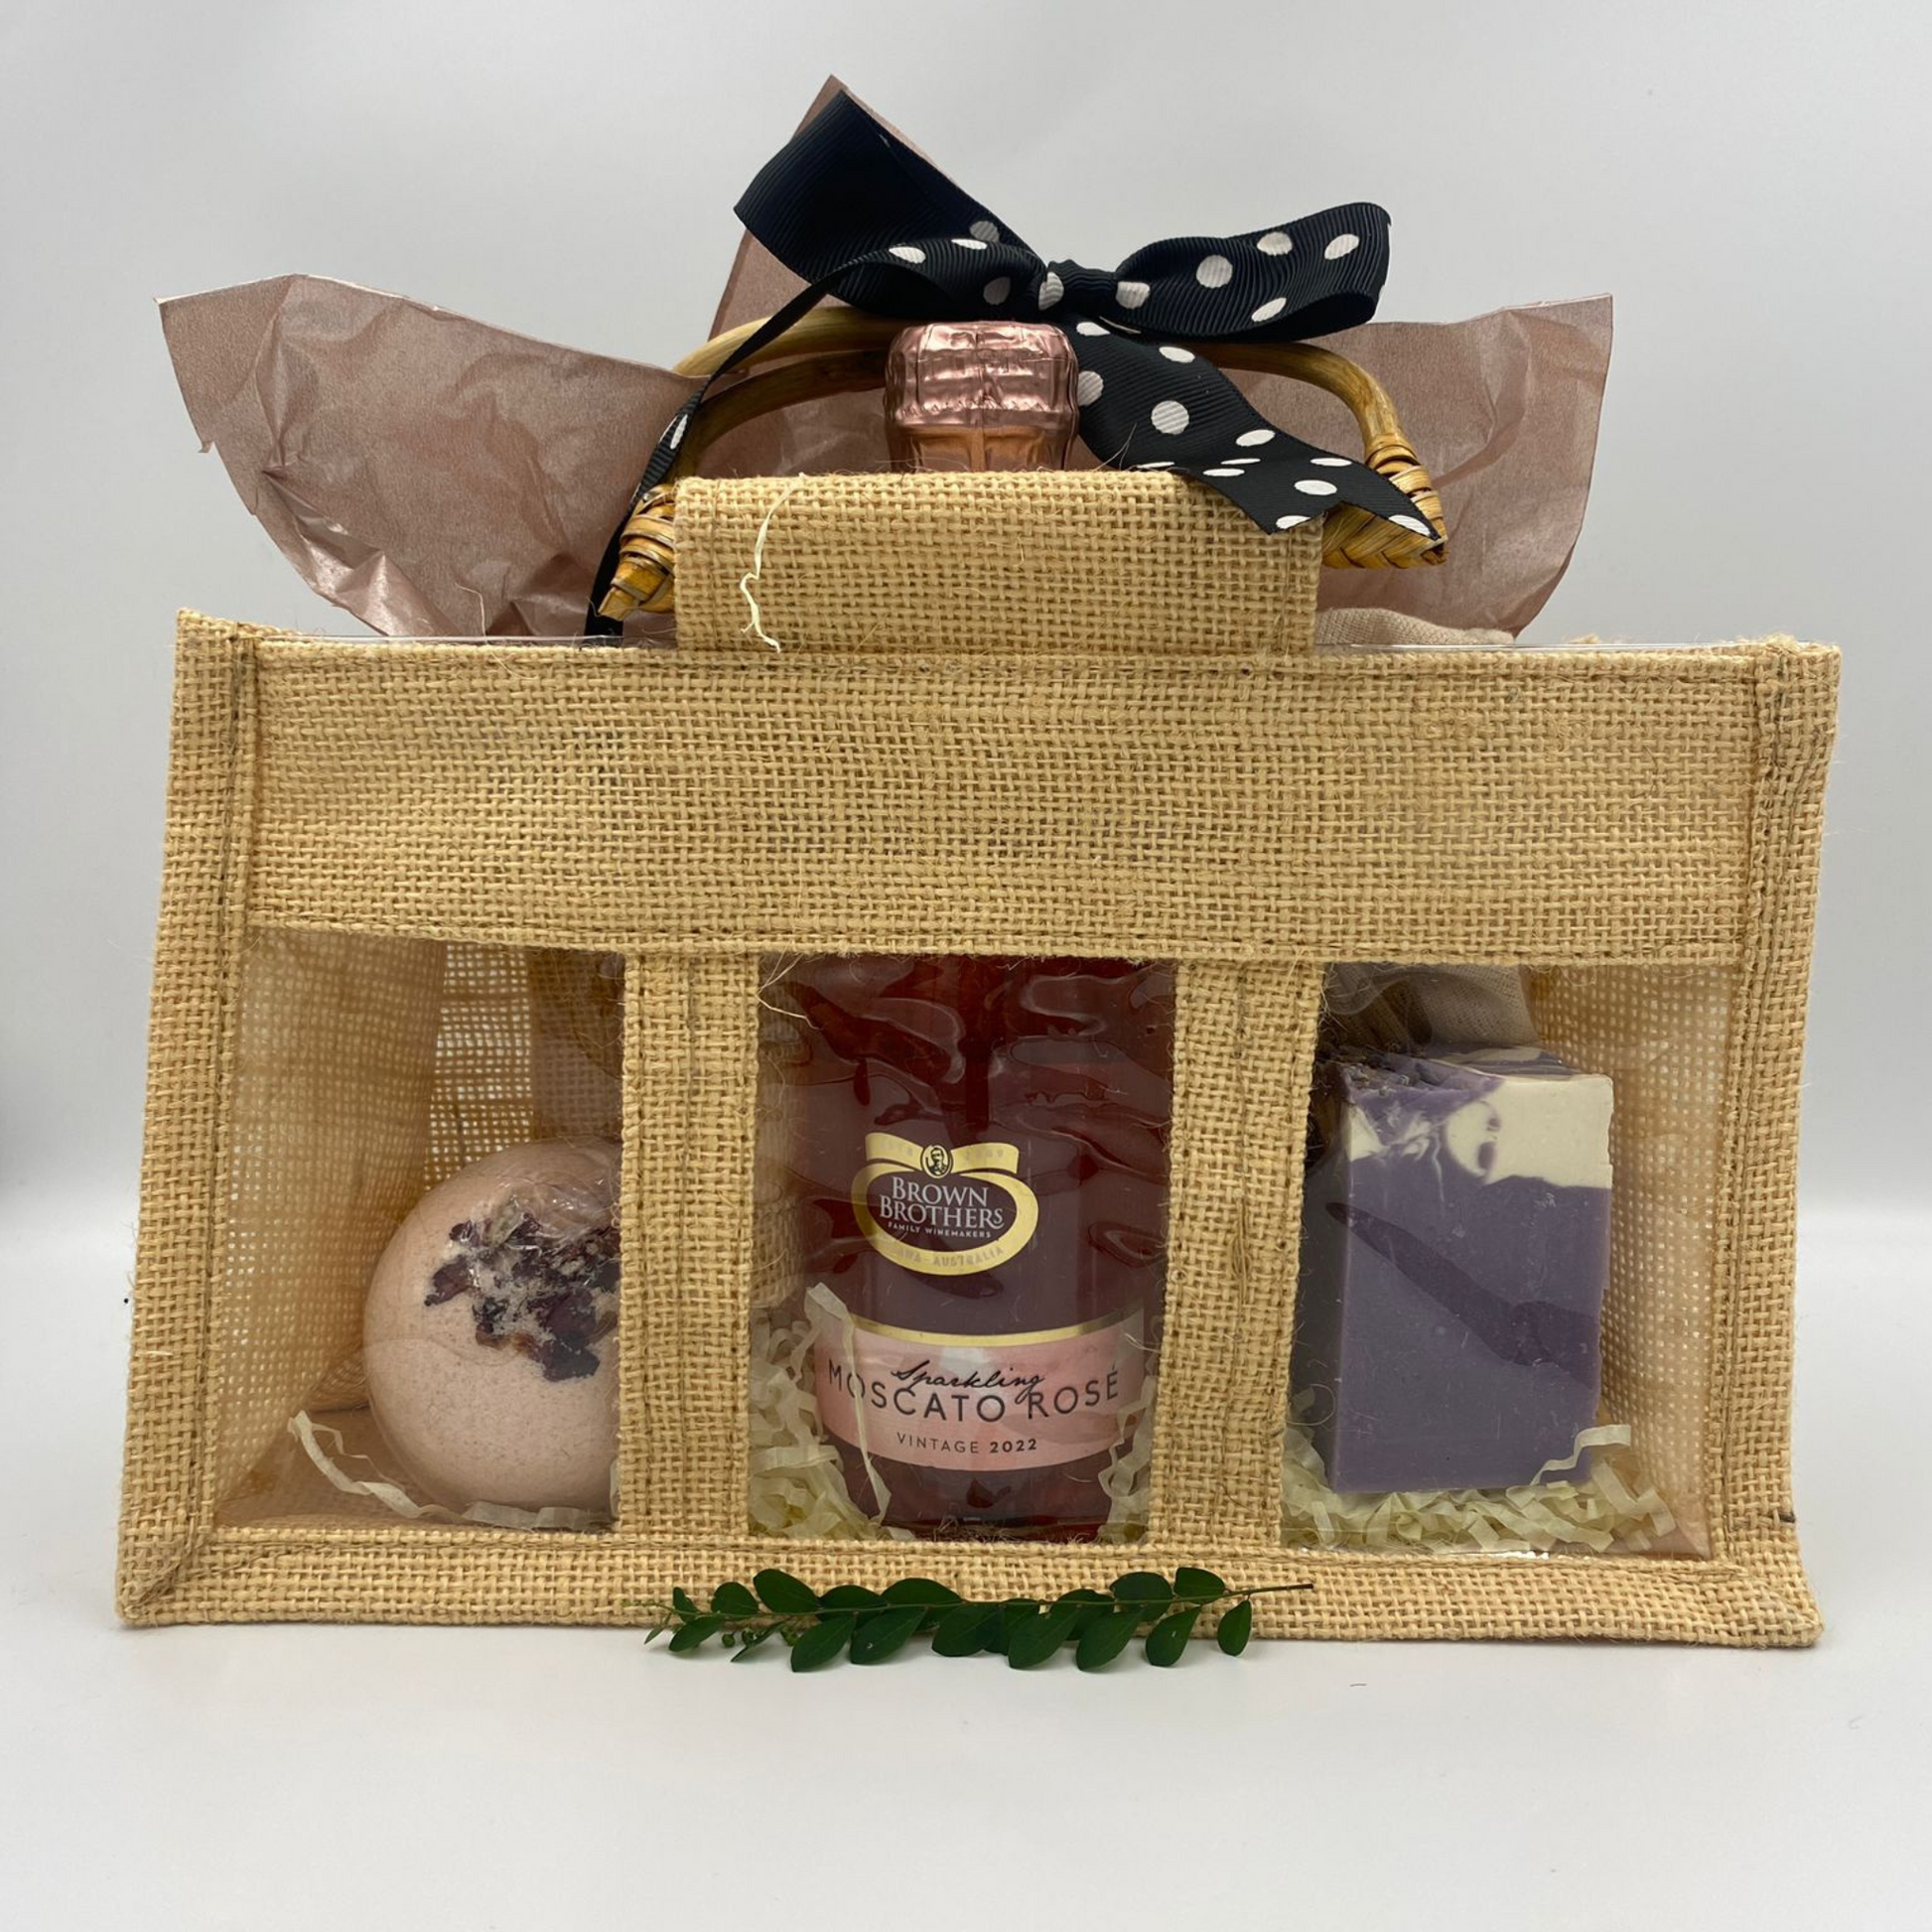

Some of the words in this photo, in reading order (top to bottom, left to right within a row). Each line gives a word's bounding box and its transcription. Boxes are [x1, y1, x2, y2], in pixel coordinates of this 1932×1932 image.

[892, 1176, 989, 1207] BROWN
[880, 1194, 1005, 1230] BROTHERS
[888, 1221, 921, 1234] FAMILY
[924, 1227, 992, 1239] WINEMAKERS
[932, 1246, 1005, 1268] AUSTRALIA
[828, 1358, 1006, 1423] MOSCATO
[1028, 1363, 1119, 1420] ROSÉ
[891, 1359, 1045, 1405] Sparkling
[897, 1432, 979, 1454] VINTAGE
[989, 1438, 1038, 1453] 2022
